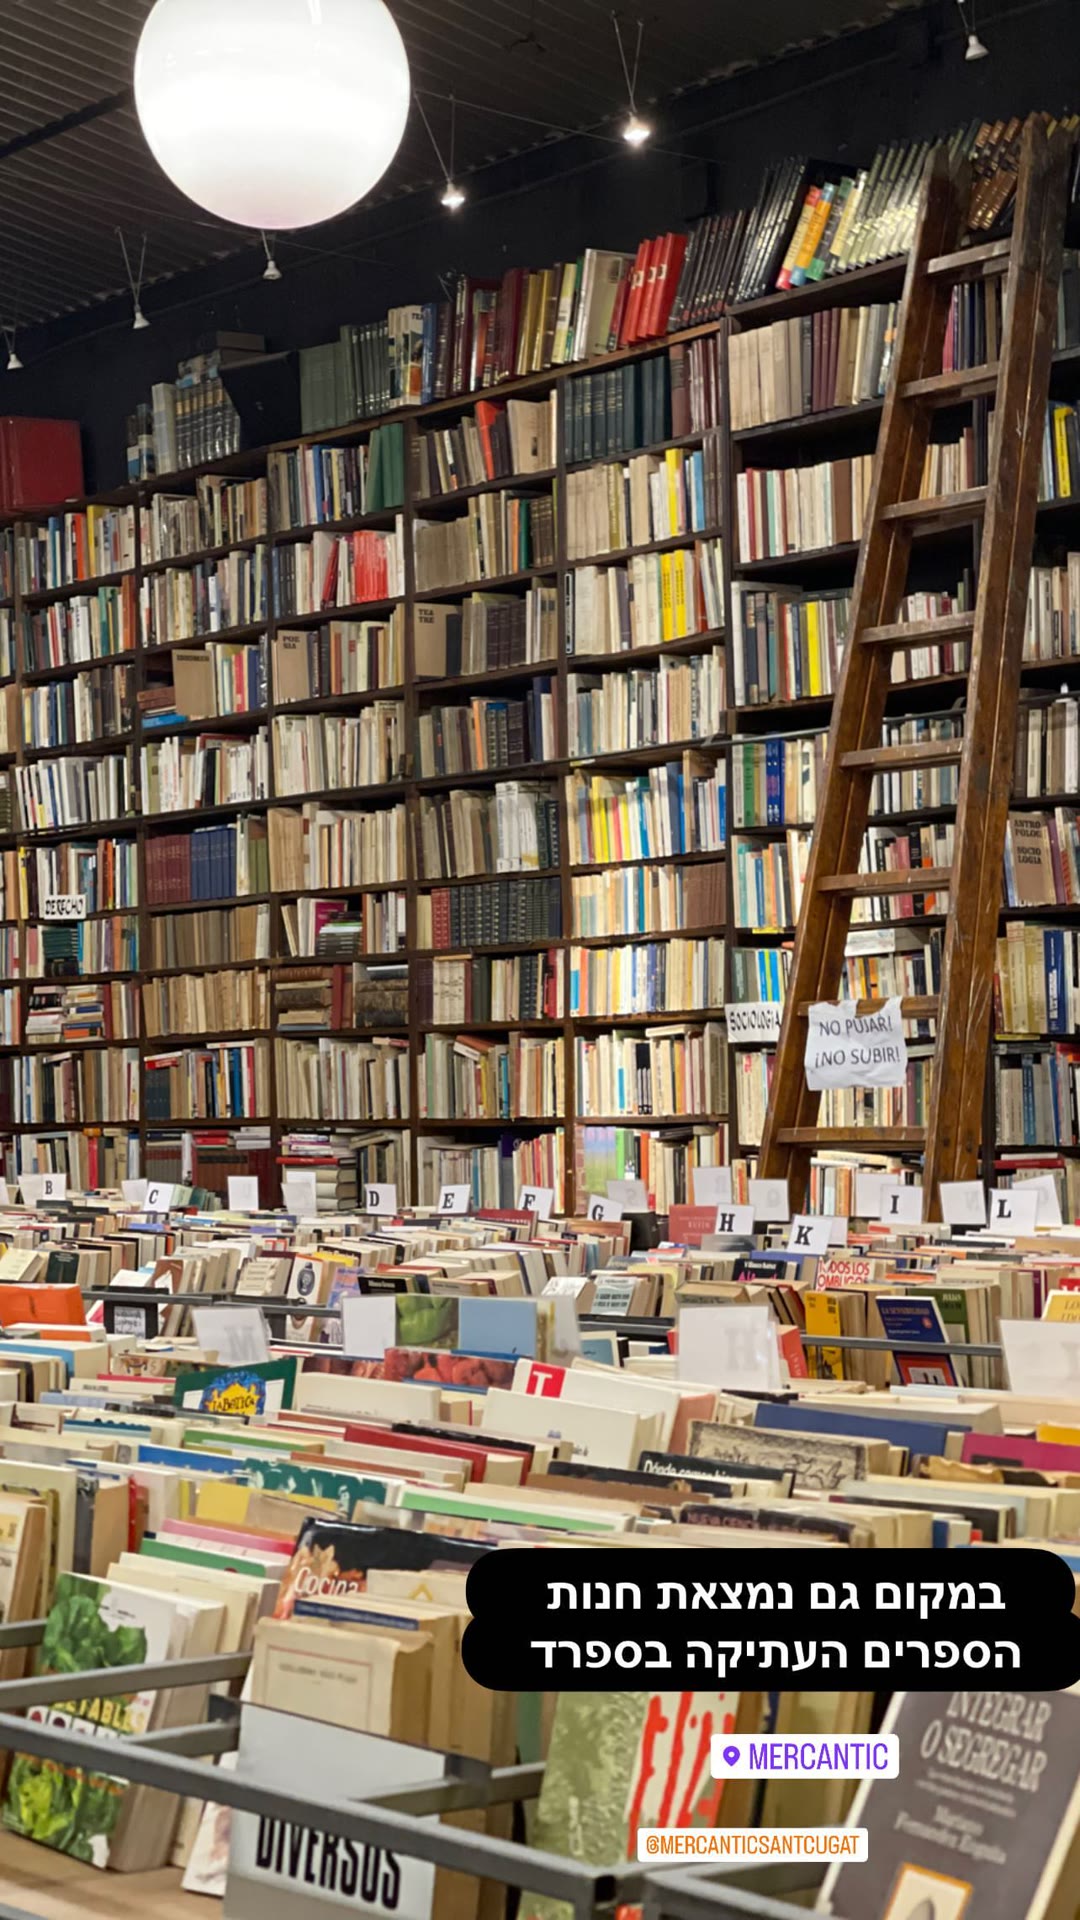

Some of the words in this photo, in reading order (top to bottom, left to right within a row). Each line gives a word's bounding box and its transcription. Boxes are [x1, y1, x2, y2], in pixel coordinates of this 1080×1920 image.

[1014, 820, 1041, 828] ANTRO
[1017, 847, 1041, 855] SOCIO
[1018, 856, 1042, 864] LOGIA
[45, 899, 83, 915] DERECHO
[819, 1020, 841, 1037] NO
[845, 1015, 893, 1036] PUJAR!
[815, 1049, 846, 1068] ¡NO
[850, 1046, 900, 1064] SUBIR!
[45, 1180, 53, 1194] B
[149, 1189, 159, 1204] C
[369, 1190, 380, 1207] D
[442, 1192, 455, 1209] E
[523, 1193, 536, 1210] F
[890, 1195, 900, 1214] I
[592, 1204, 605, 1222] G
[997, 1199, 1012, 1218] L
[718, 1213, 736, 1232] H
[795, 1225, 814, 1246] K
[818, 1259, 850, 1275] TDOS
[851, 1261, 870, 1277] LOS
[294, 1566, 359, 1596] Cocina
[920, 1719, 943, 1760] O
[937, 1725, 1049, 1793] SEGREGAR
[256, 1815, 401, 1911] DIVERSOS
